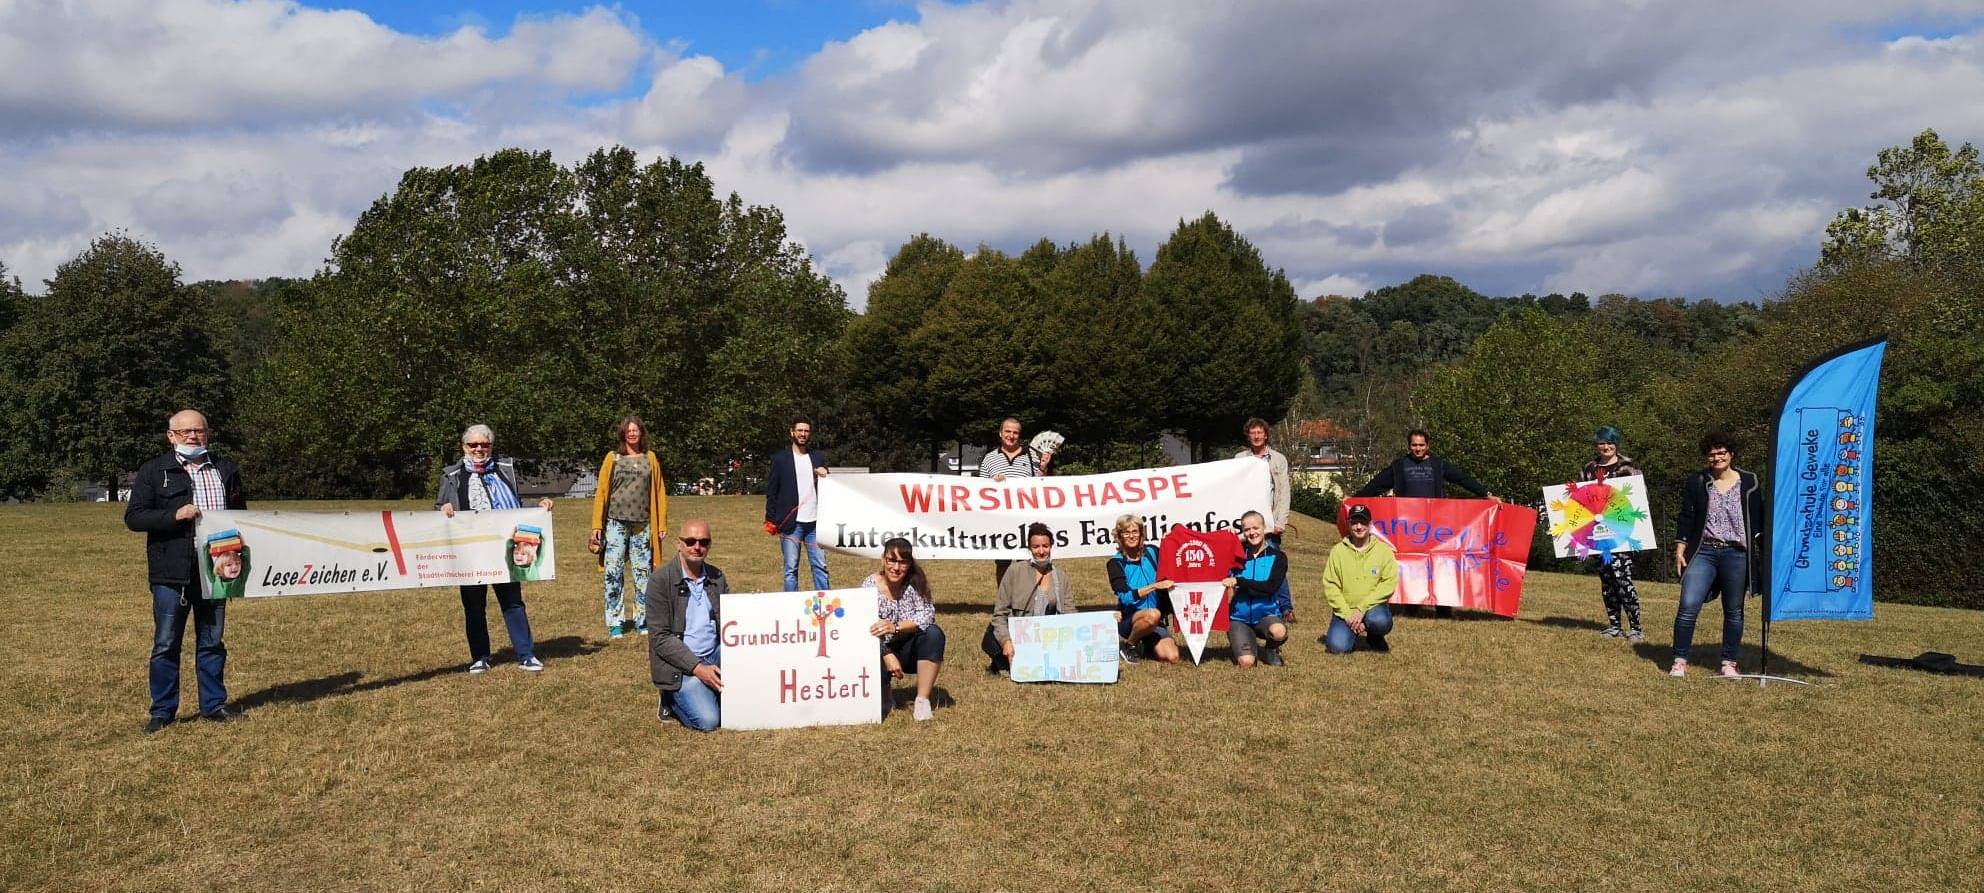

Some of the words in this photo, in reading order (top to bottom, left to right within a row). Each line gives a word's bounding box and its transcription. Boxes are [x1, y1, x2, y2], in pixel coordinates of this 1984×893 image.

[1800, 429, 1819, 481] Geweke
[899, 483, 972, 513] WIR
[979, 486, 1066, 512] SIND
[1073, 473, 1193, 508] HASPE
[835, 522, 1070, 551] Interkulturels
[1079, 511, 1244, 546] Failinfes
[1794, 484, 1818, 569] Grundschule
[1812, 520, 1823, 538] Eine
[262, 562, 357, 588] LeseZeichen
[361, 560, 388, 582] e.V.
[476, 569, 503, 578] Haspe
[1185, 549, 1205, 562] 150
[721, 618, 840, 657] Grundschule
[780, 666, 870, 704] Hestert
[1018, 651, 1102, 681] schule
